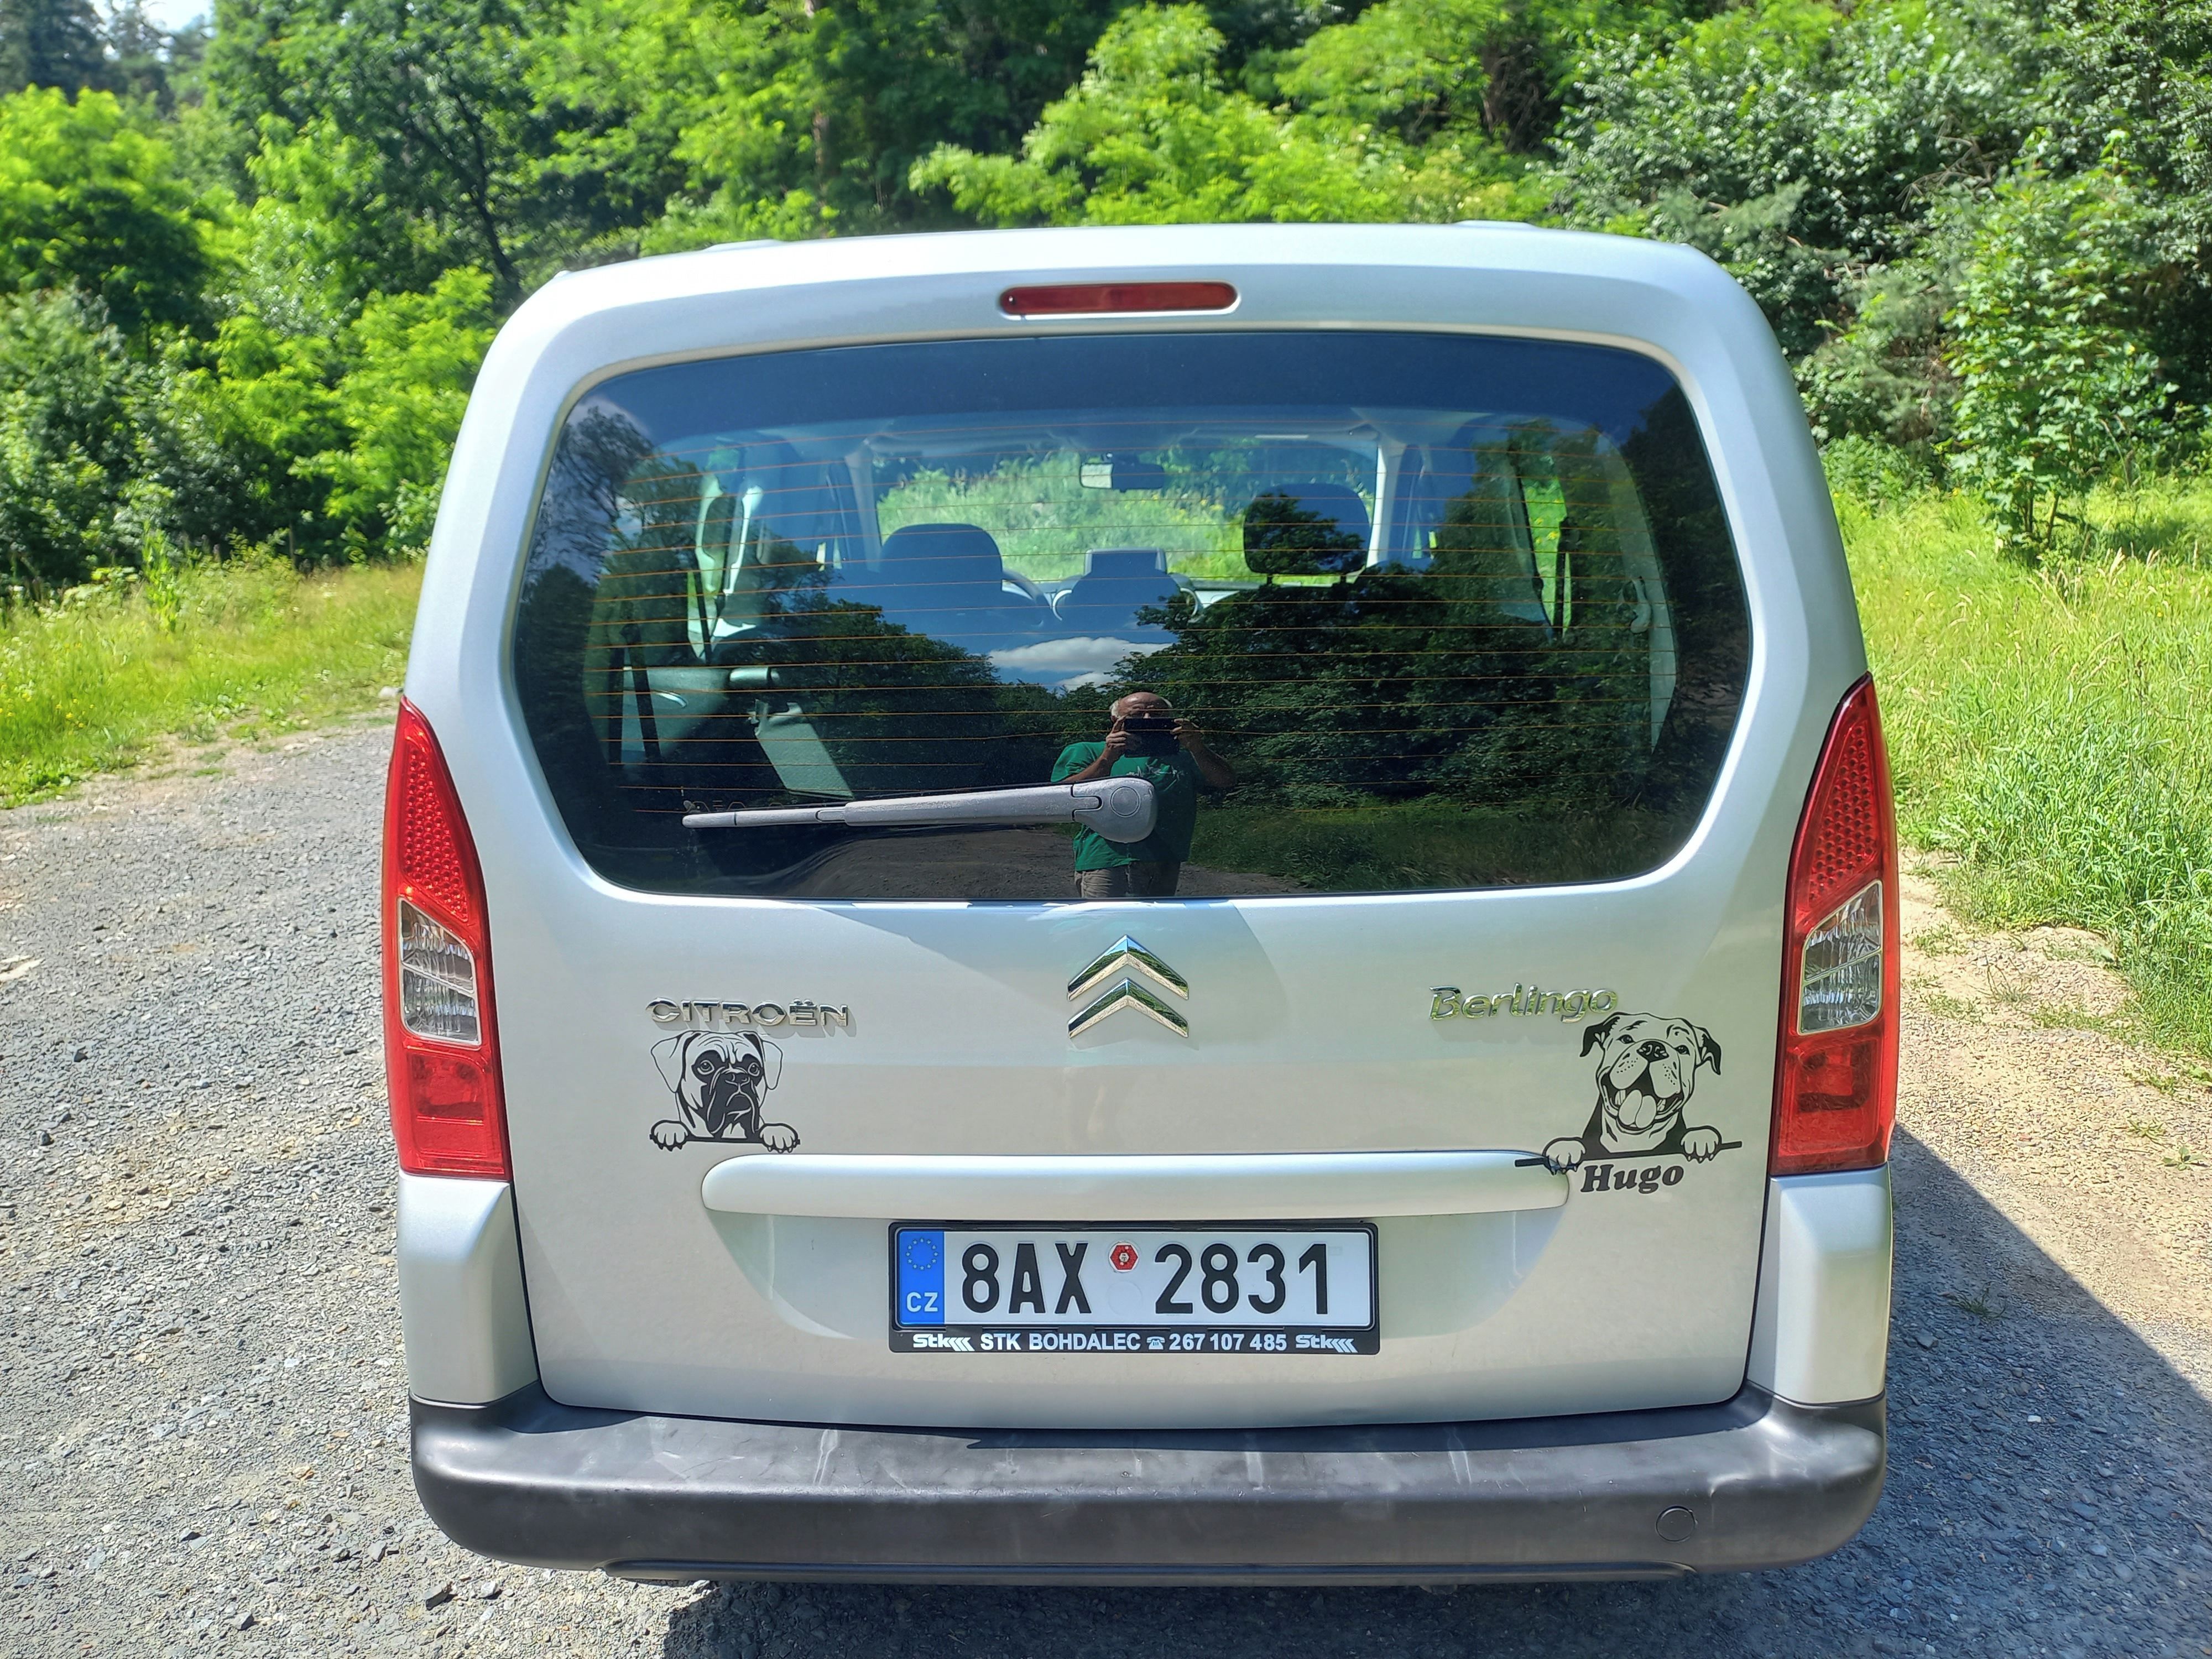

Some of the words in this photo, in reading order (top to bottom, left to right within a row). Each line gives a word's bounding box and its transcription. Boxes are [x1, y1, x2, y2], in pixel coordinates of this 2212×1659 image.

[646, 997, 848, 1026] CITROËN
[1429, 982, 1618, 1022] Berlingo
[1580, 1164, 1684, 1193] Hugo
[961, 1243, 1092, 1314] 8AX
[1155, 1243, 1327, 1314] 2831
[907, 1292, 938, 1312] CZ
[913, 1334, 950, 1348] Stk
[980, 1333, 1021, 1350] STK
[1029, 1333, 1141, 1350] BOHDALEC
[1169, 1333, 1206, 1350] 267
[1210, 1334, 1245, 1350] 107
[1250, 1334, 1286, 1350] 485
[1296, 1334, 1333, 1349] Stk
